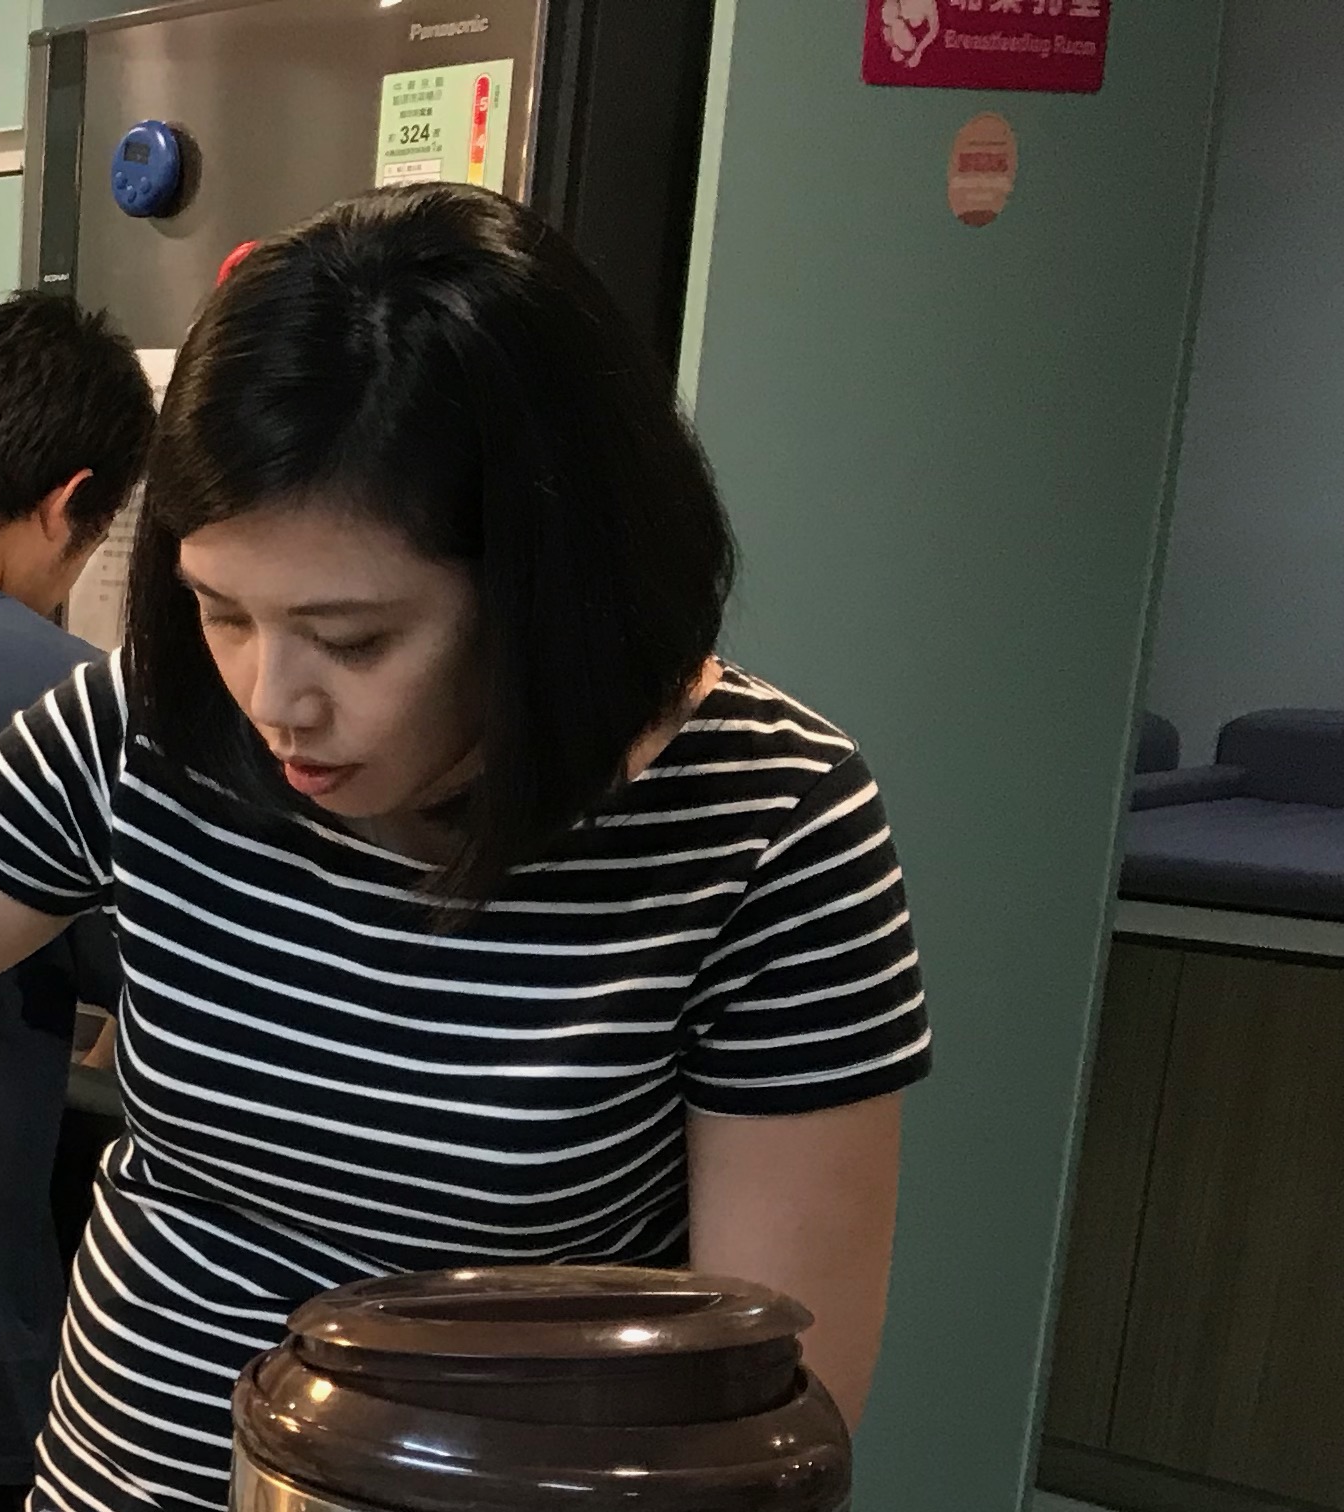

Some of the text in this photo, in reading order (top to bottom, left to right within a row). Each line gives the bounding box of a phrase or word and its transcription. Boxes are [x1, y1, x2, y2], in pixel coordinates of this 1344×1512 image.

[410, 14, 490, 40] Panasonic
[945, 29, 1096, 58] Breastfeeding Room
[400, 123, 430, 145] 324
